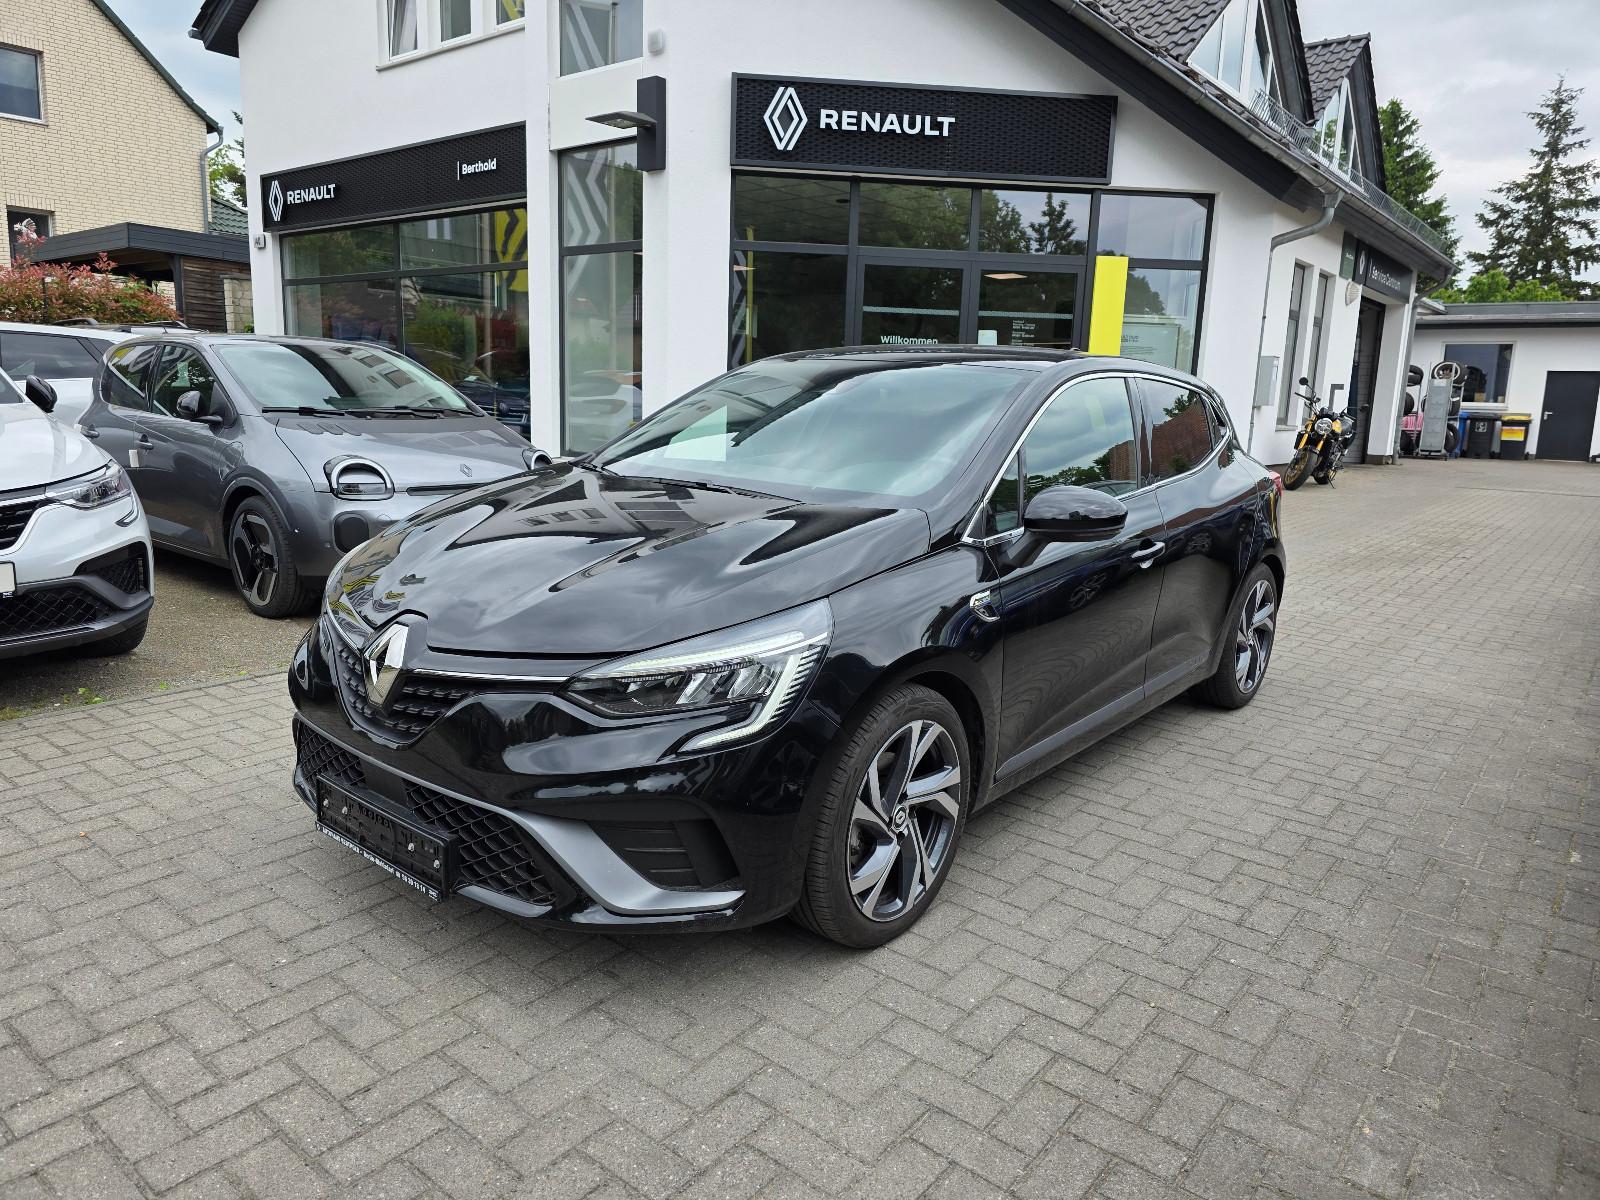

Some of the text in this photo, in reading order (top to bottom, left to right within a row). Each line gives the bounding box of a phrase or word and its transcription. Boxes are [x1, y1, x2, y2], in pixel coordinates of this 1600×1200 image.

[819, 108, 956, 137] RENAULT
[461, 157, 497, 175] Berthold
[286, 183, 336, 205] RENAULT
[880, 335, 938, 345] Willkommen
